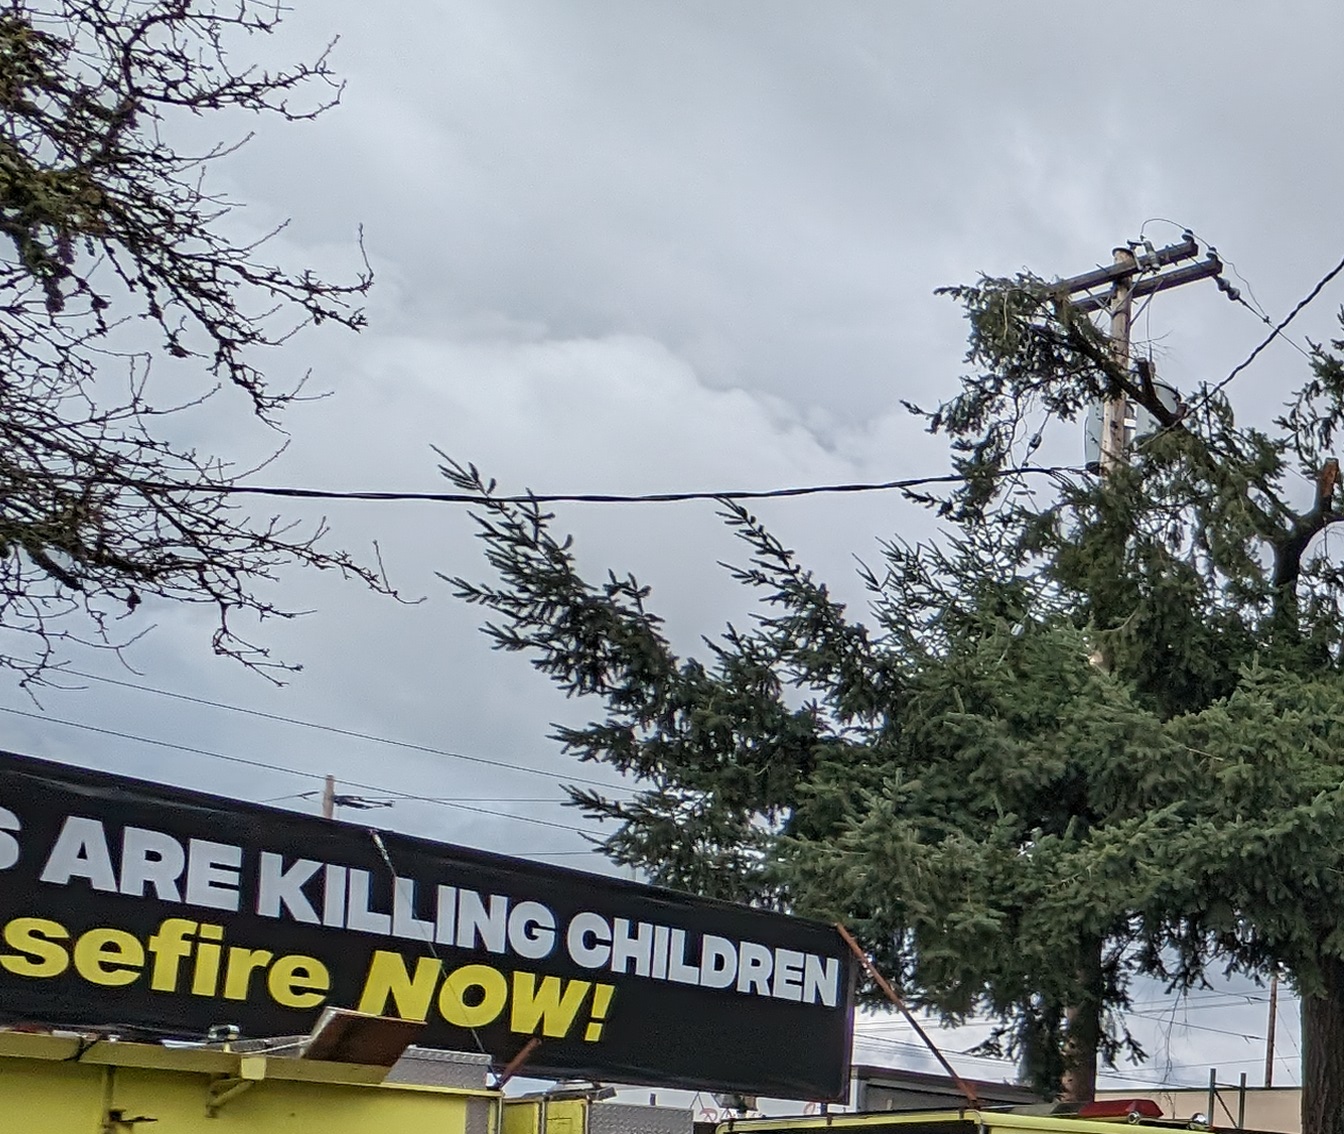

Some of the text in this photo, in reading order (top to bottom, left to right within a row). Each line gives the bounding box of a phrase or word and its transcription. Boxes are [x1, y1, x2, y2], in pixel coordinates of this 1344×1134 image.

[0, 917, 615, 1042] sefire NOW!
[39, 816, 242, 911] ARE
[256, 851, 556, 959] KILLING
[567, 912, 839, 1007] CHILDREN
